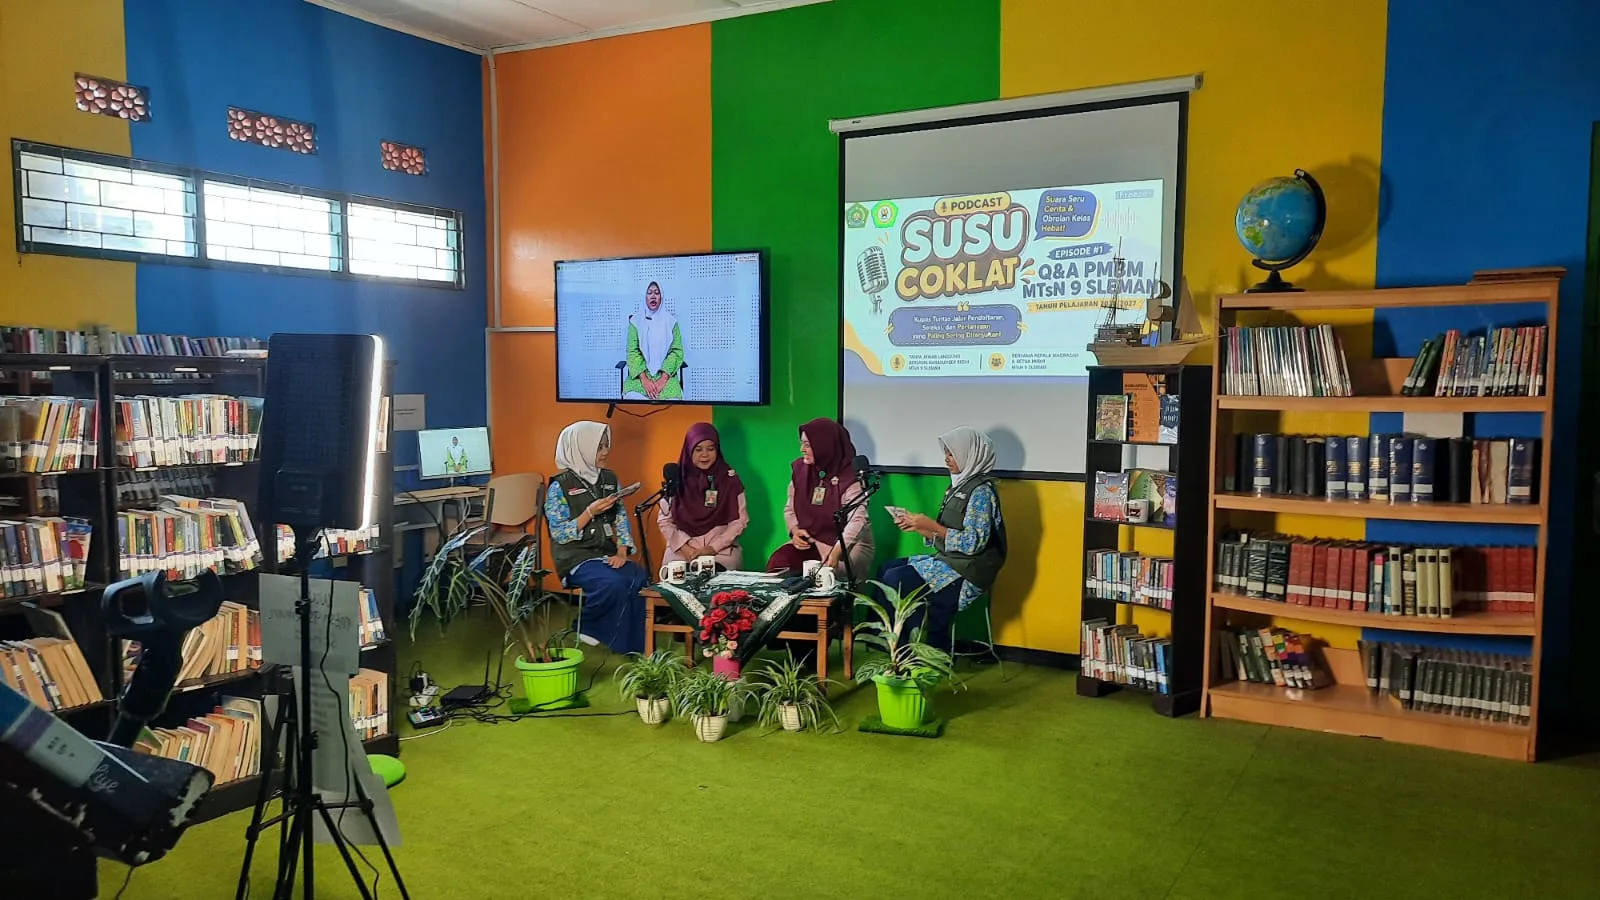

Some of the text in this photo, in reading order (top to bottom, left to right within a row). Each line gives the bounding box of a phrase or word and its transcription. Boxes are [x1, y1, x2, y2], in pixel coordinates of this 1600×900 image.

[951, 197, 1003, 211] PODCAST
[1045, 194, 1085, 203] Suara Seru
[1067, 204, 1074, 212] &
[1042, 214, 1091, 222] Obrolan Kelas
[1041, 224, 1066, 232] Hebat!
[903, 211, 1026, 263] SUSU
[1055, 245, 1104, 258] EPISODE #1
[1038, 260, 1144, 280] Q&A PMBM
[896, 257, 1020, 298] COKLAT
[1022, 279, 1159, 299] MTsN 9 SLEMAN
[1035, 302, 1058, 311] TAHUN
[1059, 300, 1098, 309] PELAJARAN
